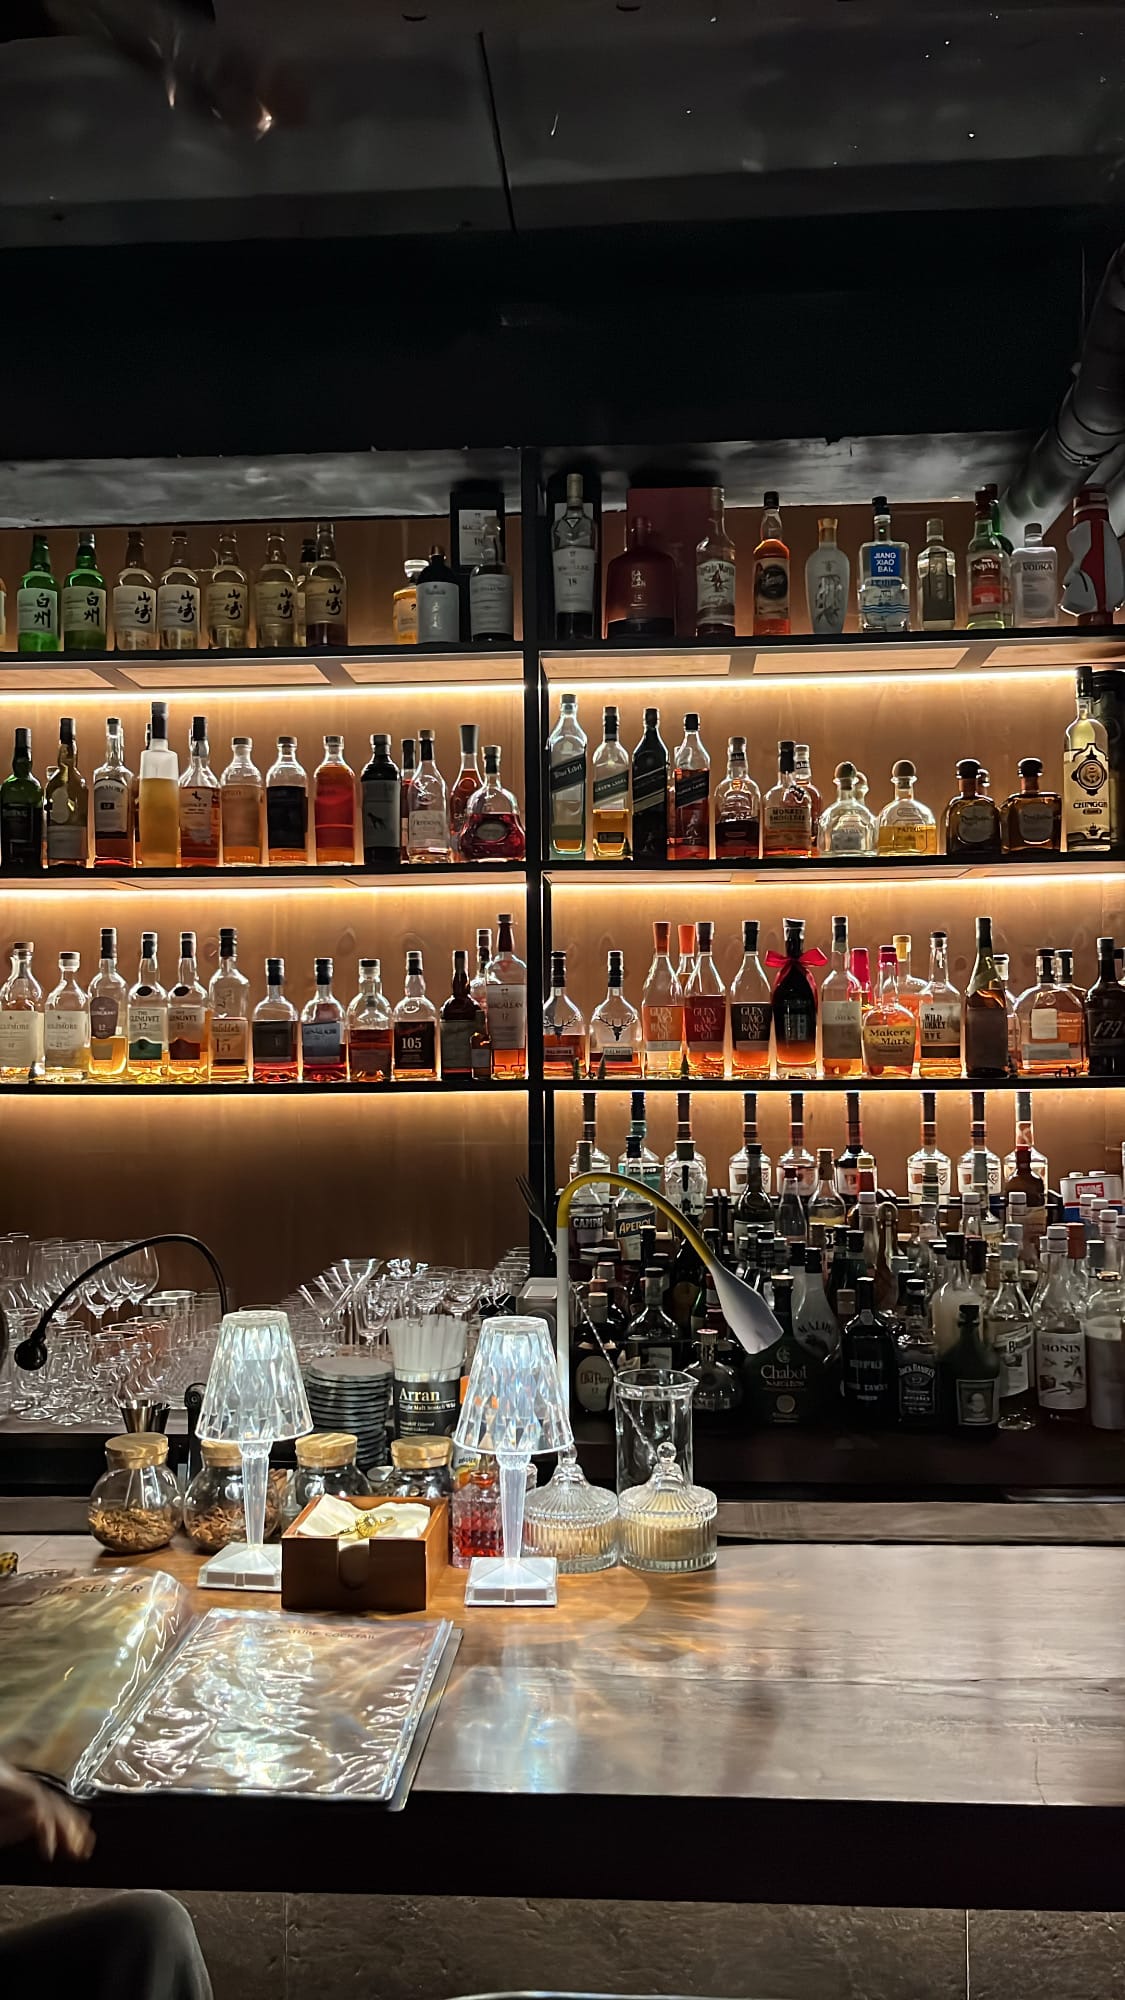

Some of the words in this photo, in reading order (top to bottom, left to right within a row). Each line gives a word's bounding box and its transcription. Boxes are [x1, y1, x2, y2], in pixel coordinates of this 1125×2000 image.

[1023, 562, 1053, 571] VODKA
[34, 592, 50, 628] 白州
[83, 591, 100, 626] 白州
[925, 1013, 942, 1021] WILD
[869, 1029, 911, 1037] Maker's
[216, 1039, 231, 1052] 15
[402, 1037, 422, 1049] 105
[881, 1036, 910, 1045] Mark
[1041, 1343, 1081, 1353] MONIN
[760, 1366, 807, 1380] Chabot
[400, 1388, 440, 1402] Arran
[79, 1584, 144, 1595] SELER
